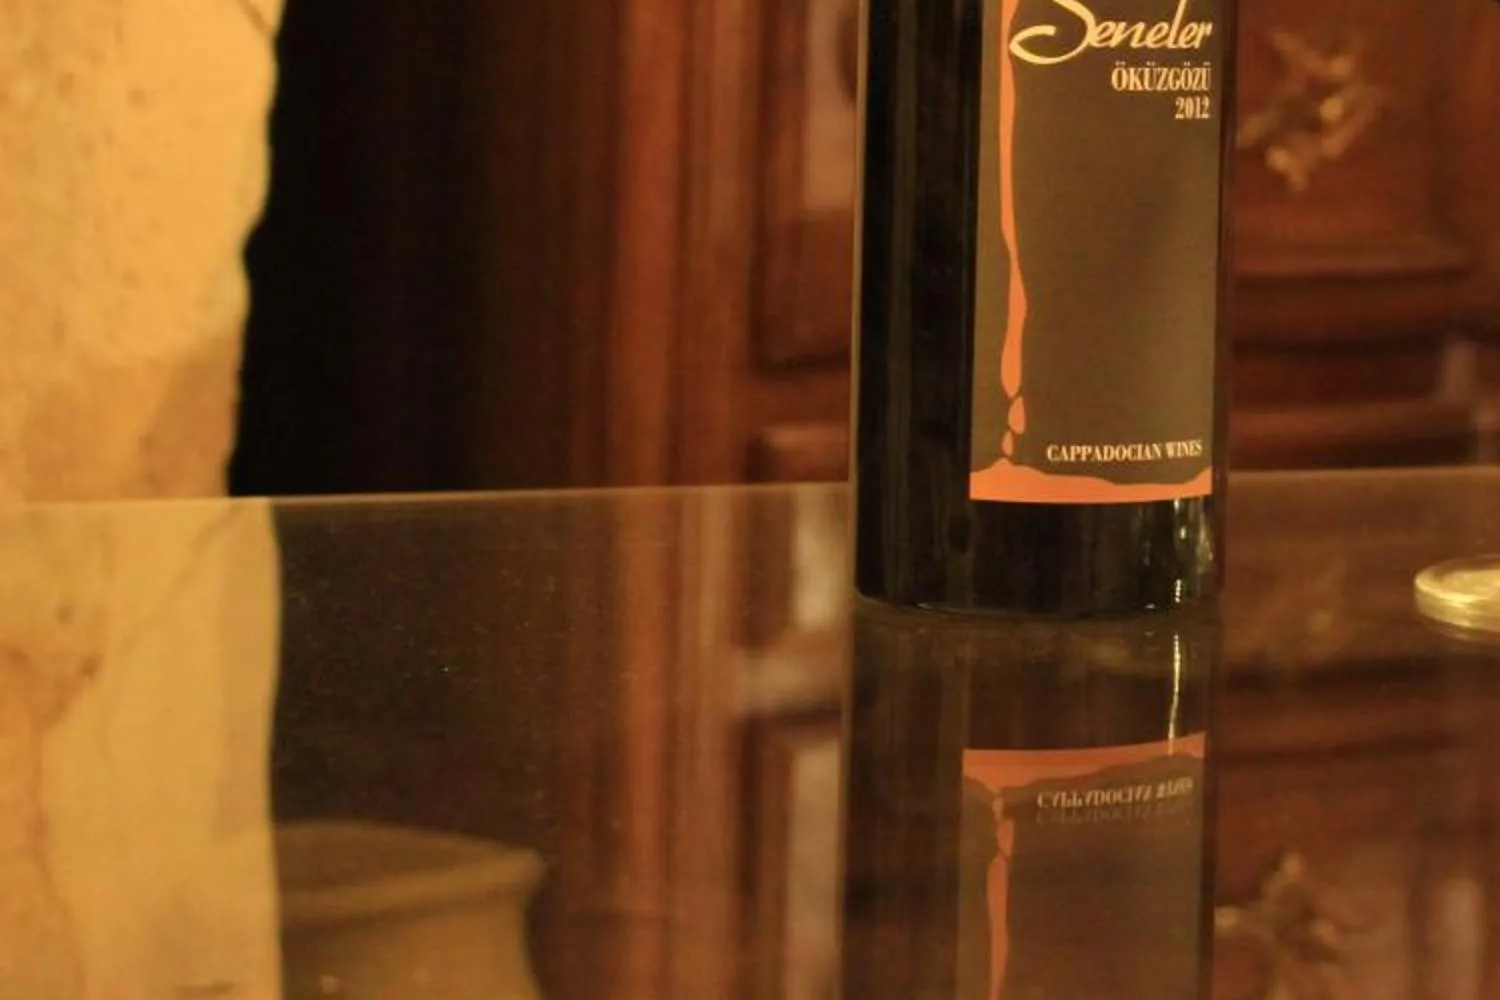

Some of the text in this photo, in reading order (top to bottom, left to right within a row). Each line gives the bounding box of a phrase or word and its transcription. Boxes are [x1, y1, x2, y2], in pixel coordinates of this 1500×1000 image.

[1111, 61, 1211, 91] ÖKÜZGÖZÜ
[1175, 97, 1210, 119] 2012
[1046, 439, 1203, 463] CAPPADOCIAN WINES
